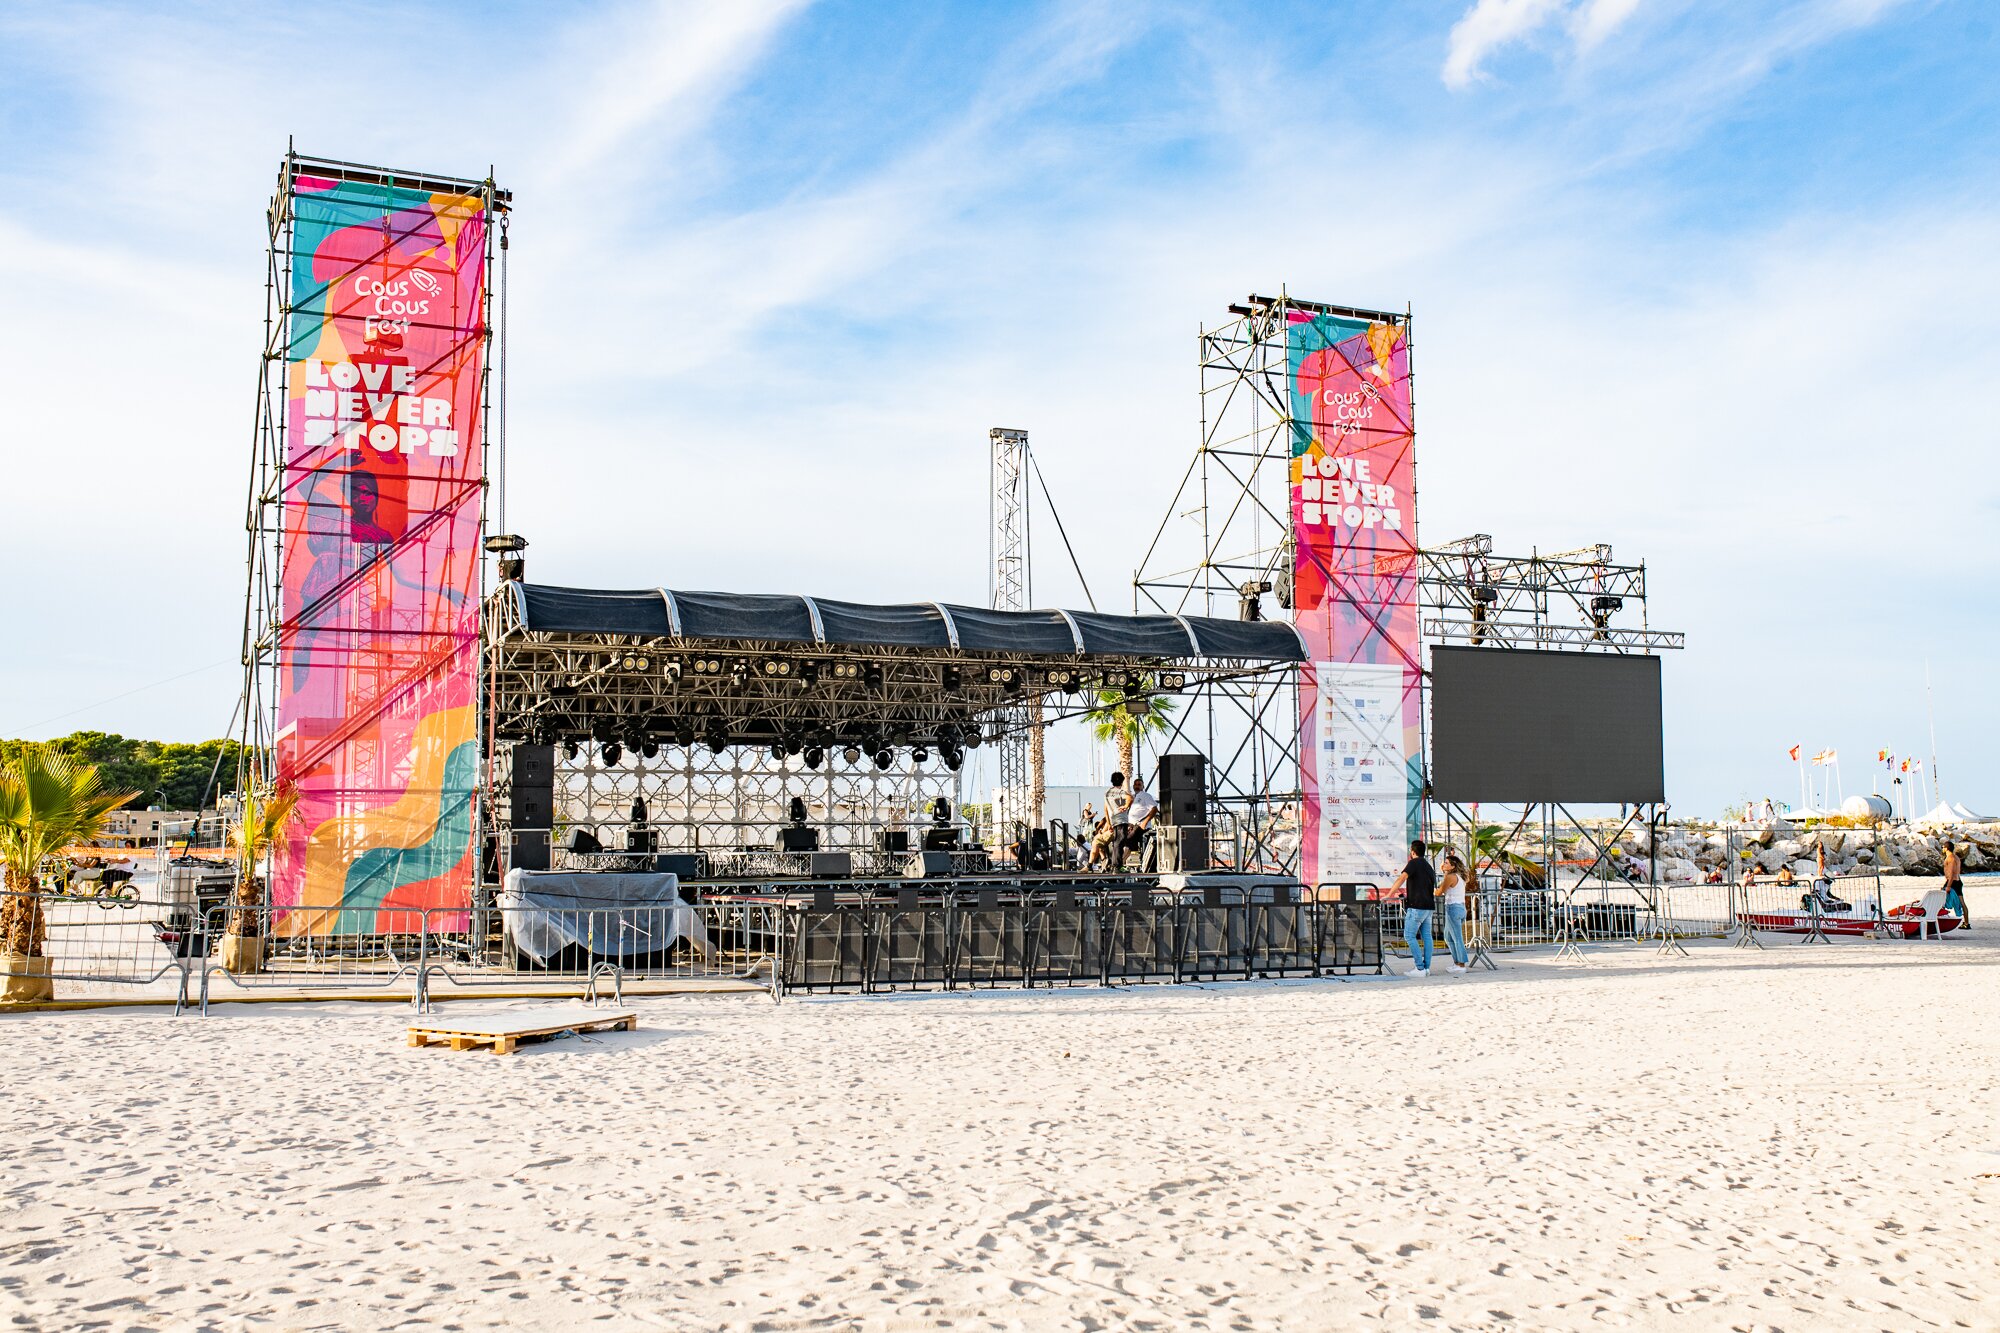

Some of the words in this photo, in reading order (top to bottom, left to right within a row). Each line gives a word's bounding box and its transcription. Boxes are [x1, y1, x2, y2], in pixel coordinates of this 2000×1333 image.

[354, 276, 409, 297] Cous
[374, 296, 430, 316] Cous
[365, 316, 411, 335] Fest
[305, 358, 417, 394] LOVE
[304, 389, 453, 427] NEVER
[1323, 389, 1360, 407] Cous
[1337, 404, 1373, 420] Cous
[304, 419, 459, 456] STOPS
[1333, 419, 1363, 434] Fest
[1302, 454, 1371, 481] LOVE
[1302, 479, 1395, 506] NEVER
[1302, 502, 1402, 528] STOPS
